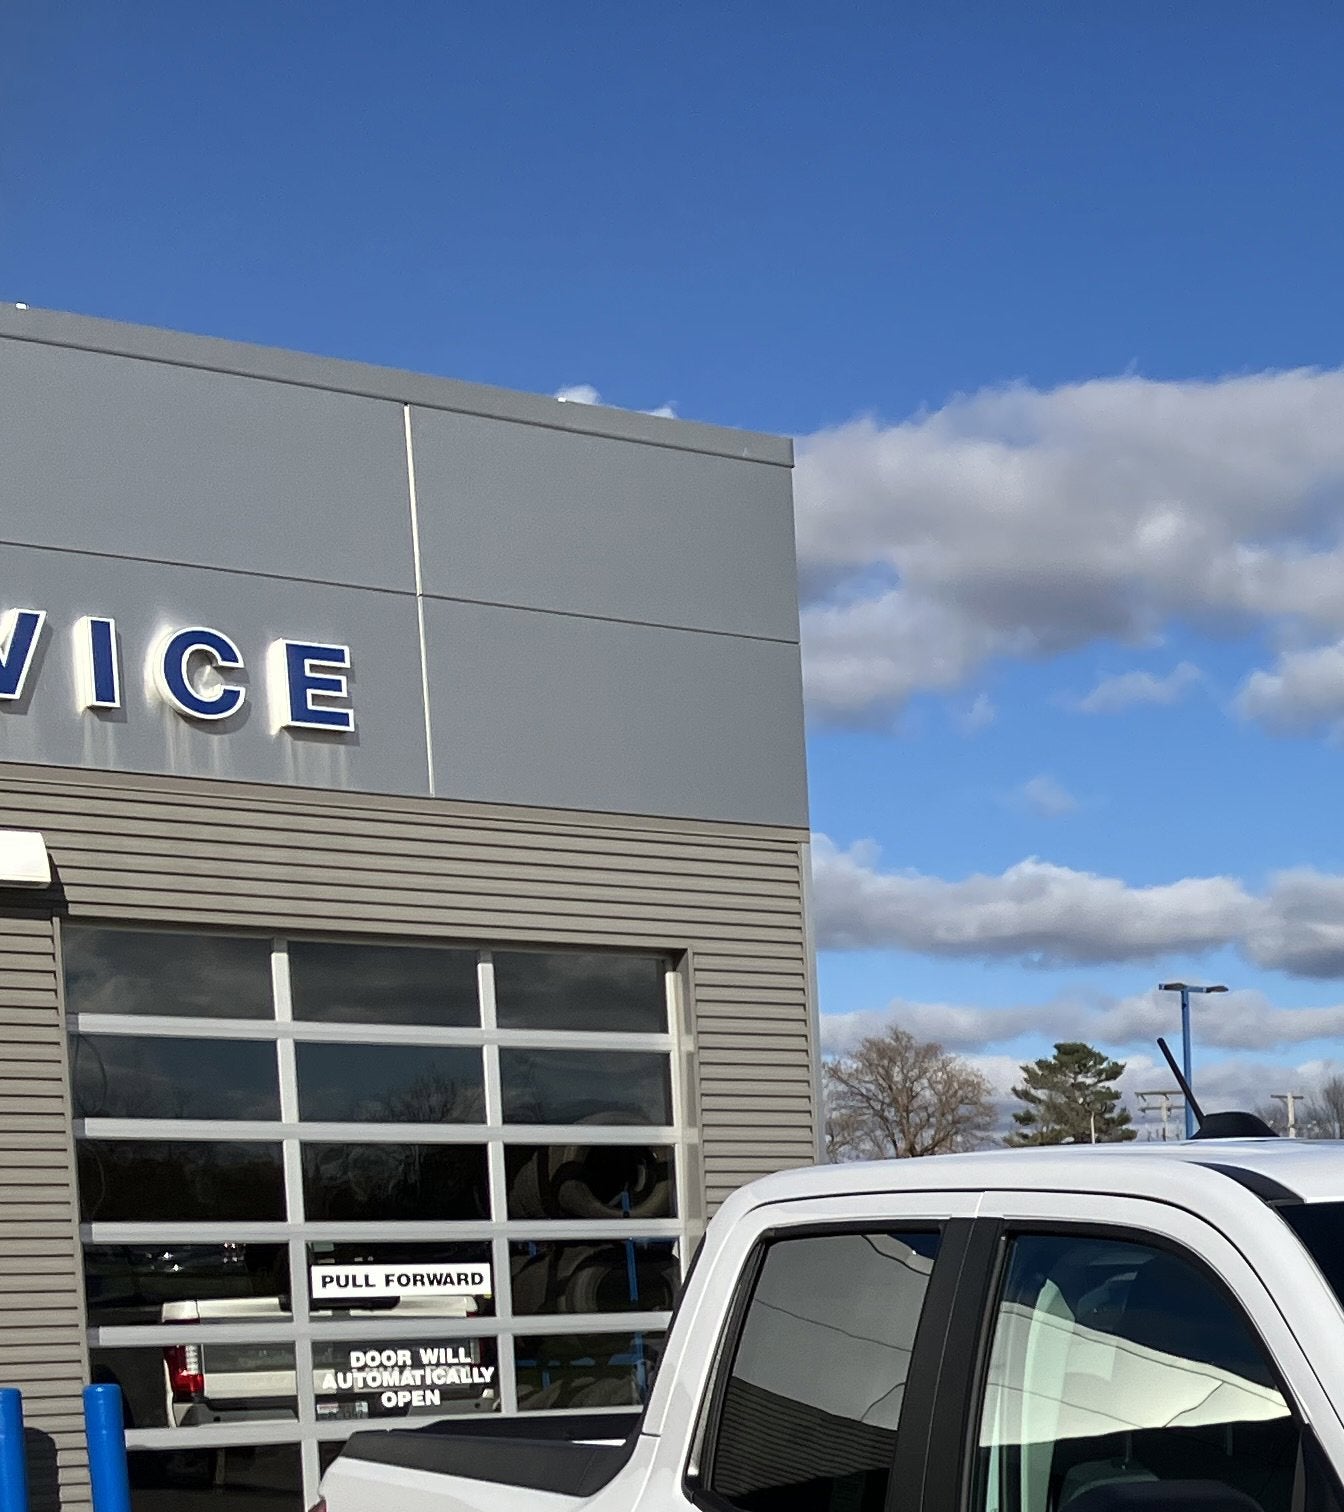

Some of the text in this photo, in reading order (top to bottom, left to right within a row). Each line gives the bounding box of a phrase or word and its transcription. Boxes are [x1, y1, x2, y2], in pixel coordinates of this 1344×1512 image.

[321, 1272, 484, 1289] PULL FORWARD
[349, 1347, 472, 1368] DOOR WILL
[322, 1366, 495, 1390] AUTOMATICALLY
[381, 1389, 441, 1408] OPEN
